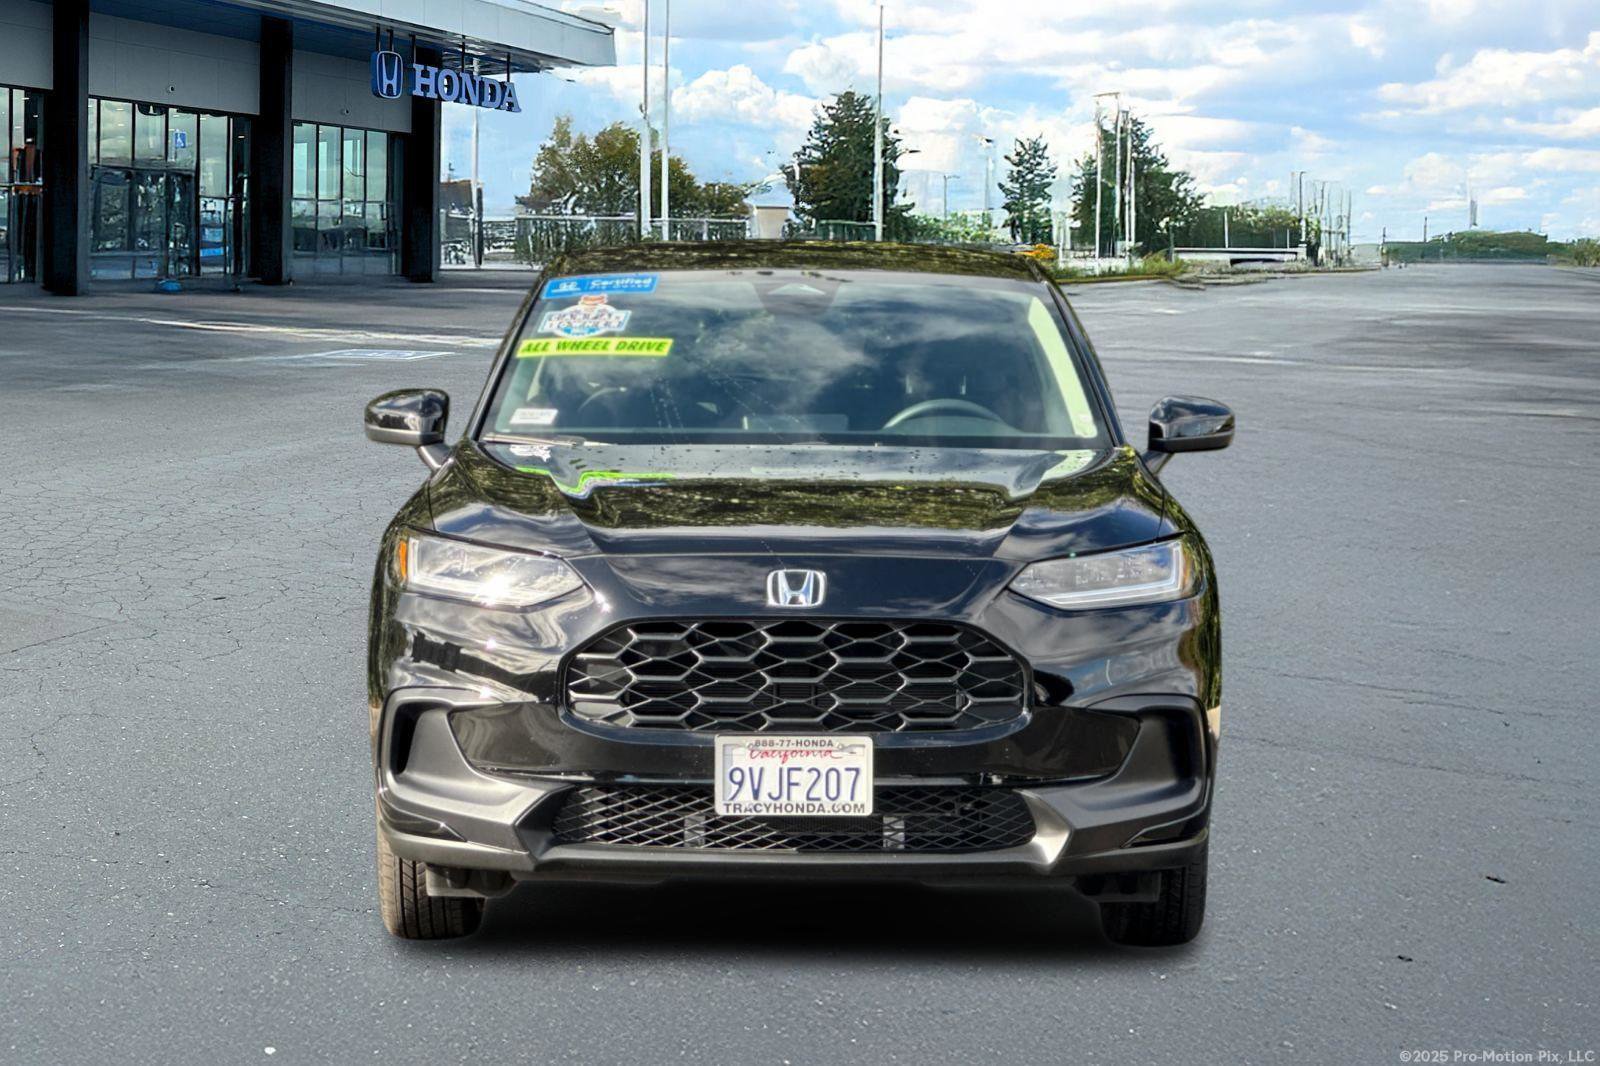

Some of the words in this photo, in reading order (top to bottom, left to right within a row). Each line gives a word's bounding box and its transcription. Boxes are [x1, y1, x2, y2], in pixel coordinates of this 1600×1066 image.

[412, 63, 522, 112] HONDA
[591, 277, 652, 287] Certified
[521, 342, 550, 352] ALL
[555, 341, 611, 351] WHEEL
[615, 341, 668, 351] DRIVE
[728, 767, 861, 801] 9VJF207
[724, 803, 866, 813] TRACYHONDA.COM
